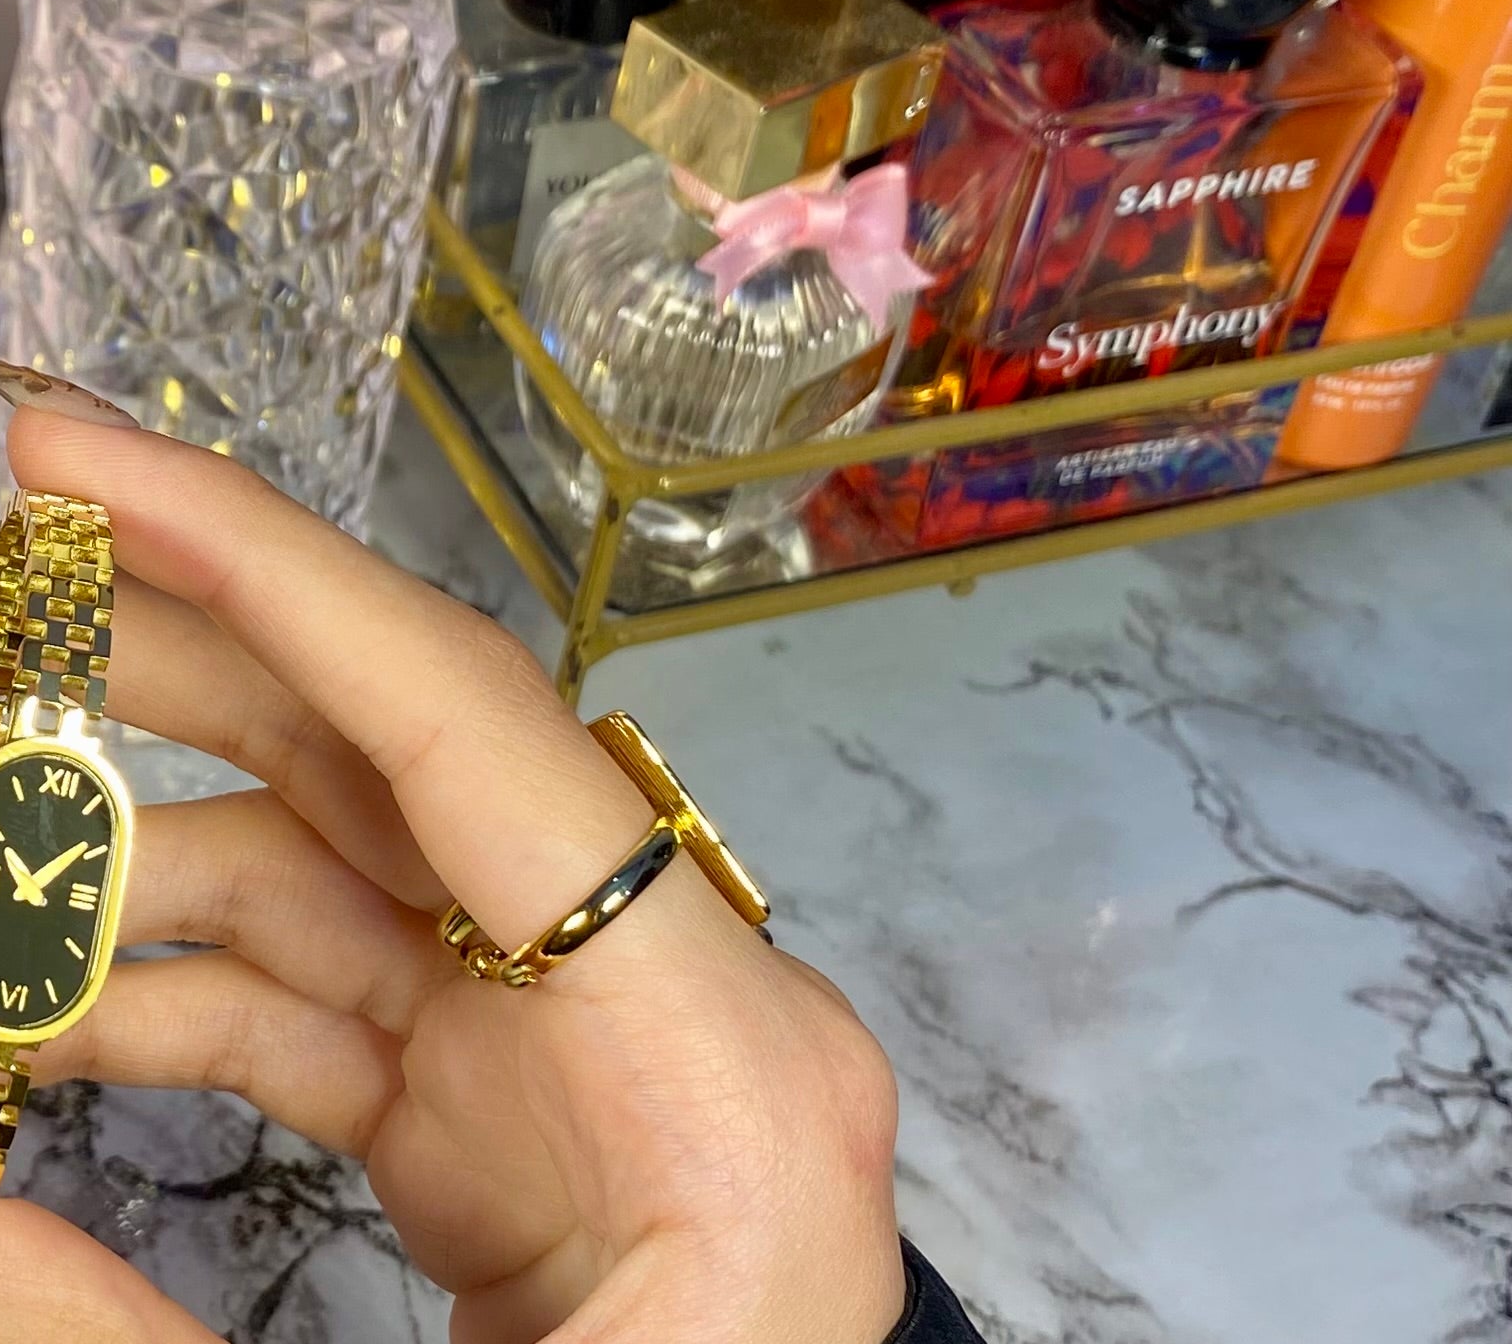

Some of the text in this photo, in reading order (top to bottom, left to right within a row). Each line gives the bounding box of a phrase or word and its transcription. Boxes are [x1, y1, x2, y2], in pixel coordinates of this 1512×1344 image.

[1114, 157, 1320, 217] SAPPHIRE
[1038, 300, 1292, 378] Symphony
[38, 764, 81, 800] XII
[0, 979, 29, 1013] VI
